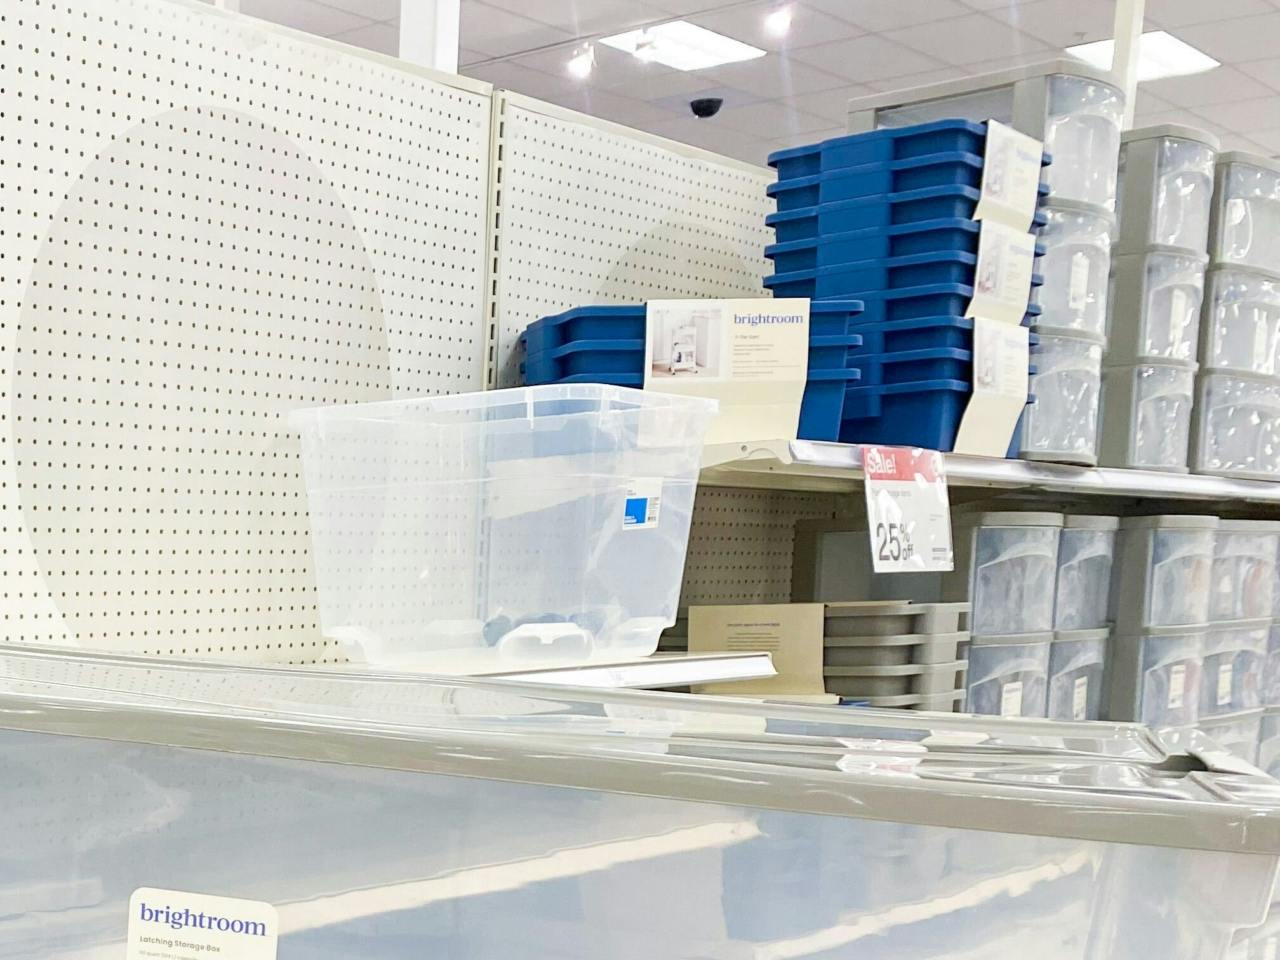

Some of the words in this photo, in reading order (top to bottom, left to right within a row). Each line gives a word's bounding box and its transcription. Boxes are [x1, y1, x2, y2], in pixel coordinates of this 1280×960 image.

[734, 313, 803, 326] brightroom
[140, 903, 266, 937] brightroom
[140, 936, 173, 947] Latching
[174, 940, 205, 951] Storage
